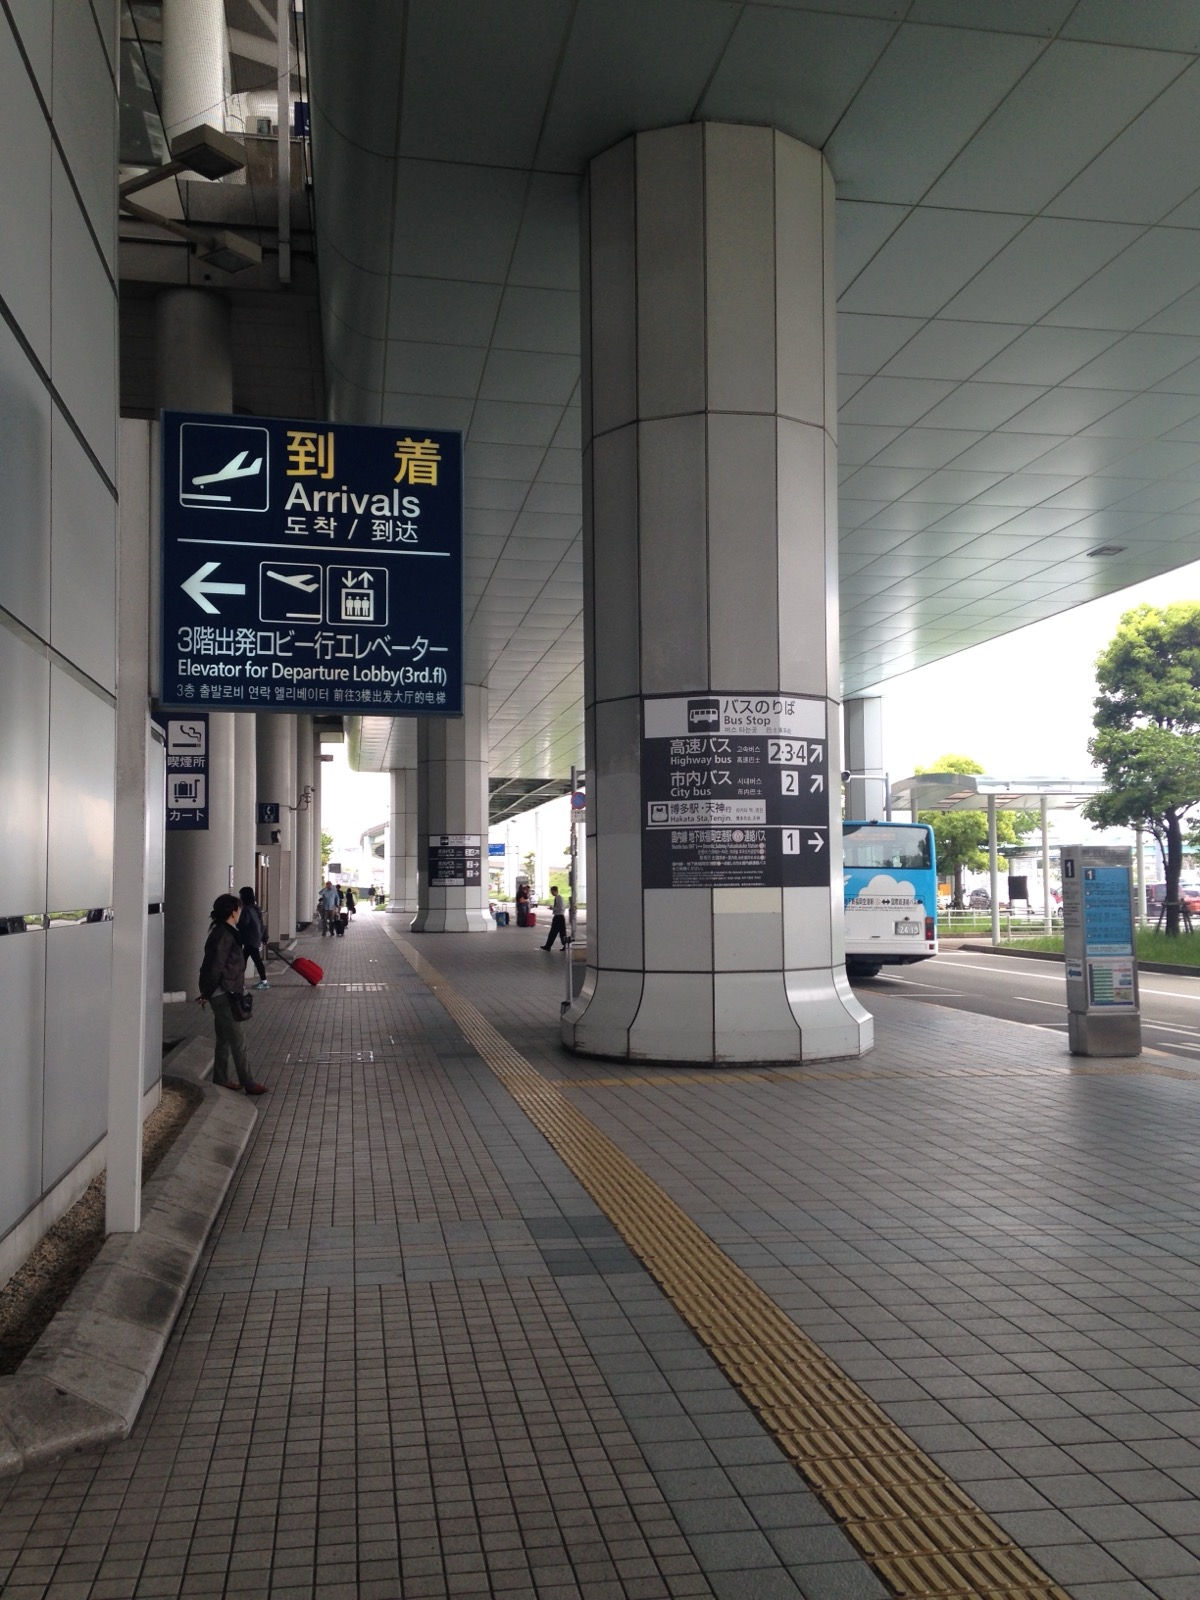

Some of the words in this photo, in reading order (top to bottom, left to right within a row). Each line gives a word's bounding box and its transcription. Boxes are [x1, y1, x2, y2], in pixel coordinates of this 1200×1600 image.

[284, 482, 421, 518] Arrivals
[284, 516, 338, 539] 도착
[371, 519, 419, 543] 到达
[177, 626, 449, 661] 3階出発ロビー行エレベーター
[178, 659, 242, 677] Elevator
[245, 661, 269, 678] for
[271, 662, 349, 684] Departure
[177, 683, 195, 698] 3층
[200, 683, 244, 699] 출발로비
[723, 699, 796, 716] バスのりば
[724, 715, 743, 725] Bus
[746, 715, 771, 727] Stop
[670, 738, 732, 755] 高速バス
[167, 756, 205, 768] 喫煙所
[670, 754, 712, 767] Highway
[714, 754, 732, 764] bus
[670, 771, 732, 787] 市内バス
[785, 773, 795, 793] 2
[670, 787, 690, 798] City
[693, 786, 712, 797] bus
[169, 810, 204, 821] カート
[787, 832, 793, 851] 1
